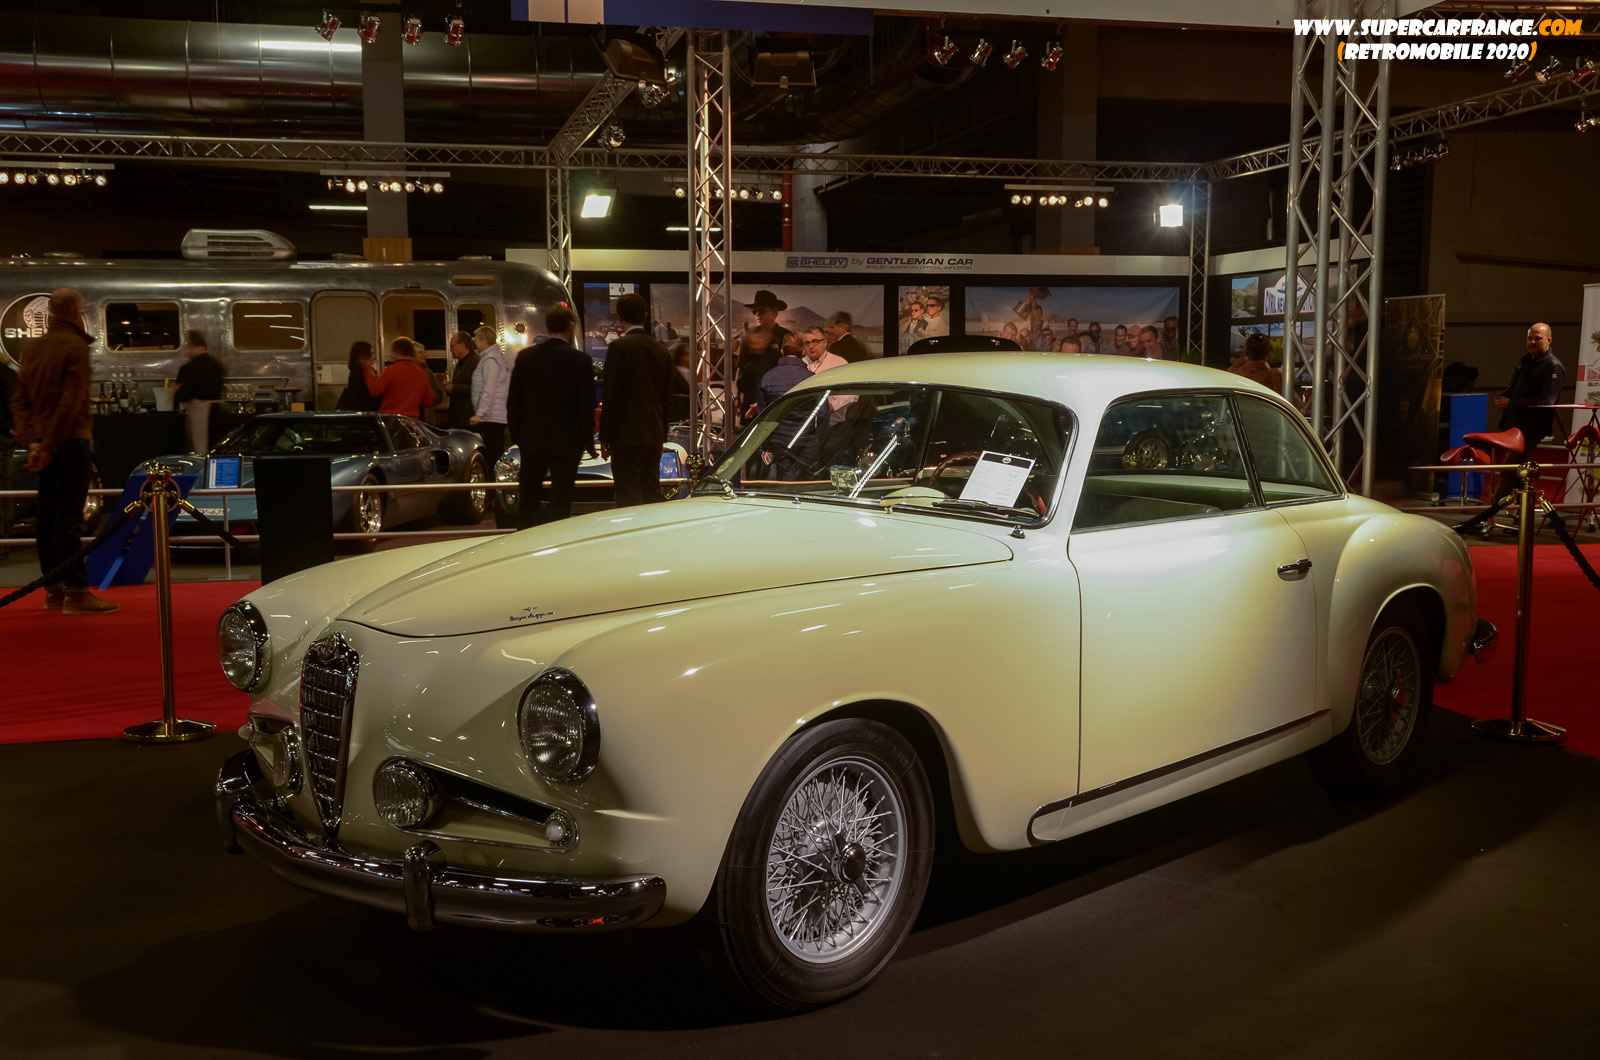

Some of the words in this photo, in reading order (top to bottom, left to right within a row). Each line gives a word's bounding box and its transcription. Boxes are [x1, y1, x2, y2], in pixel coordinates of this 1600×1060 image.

[800, 258, 845, 266] SHELBY
[851, 257, 865, 266] by
[866, 257, 944, 265] GENTLEMAN
[947, 258, 974, 266] CAR
